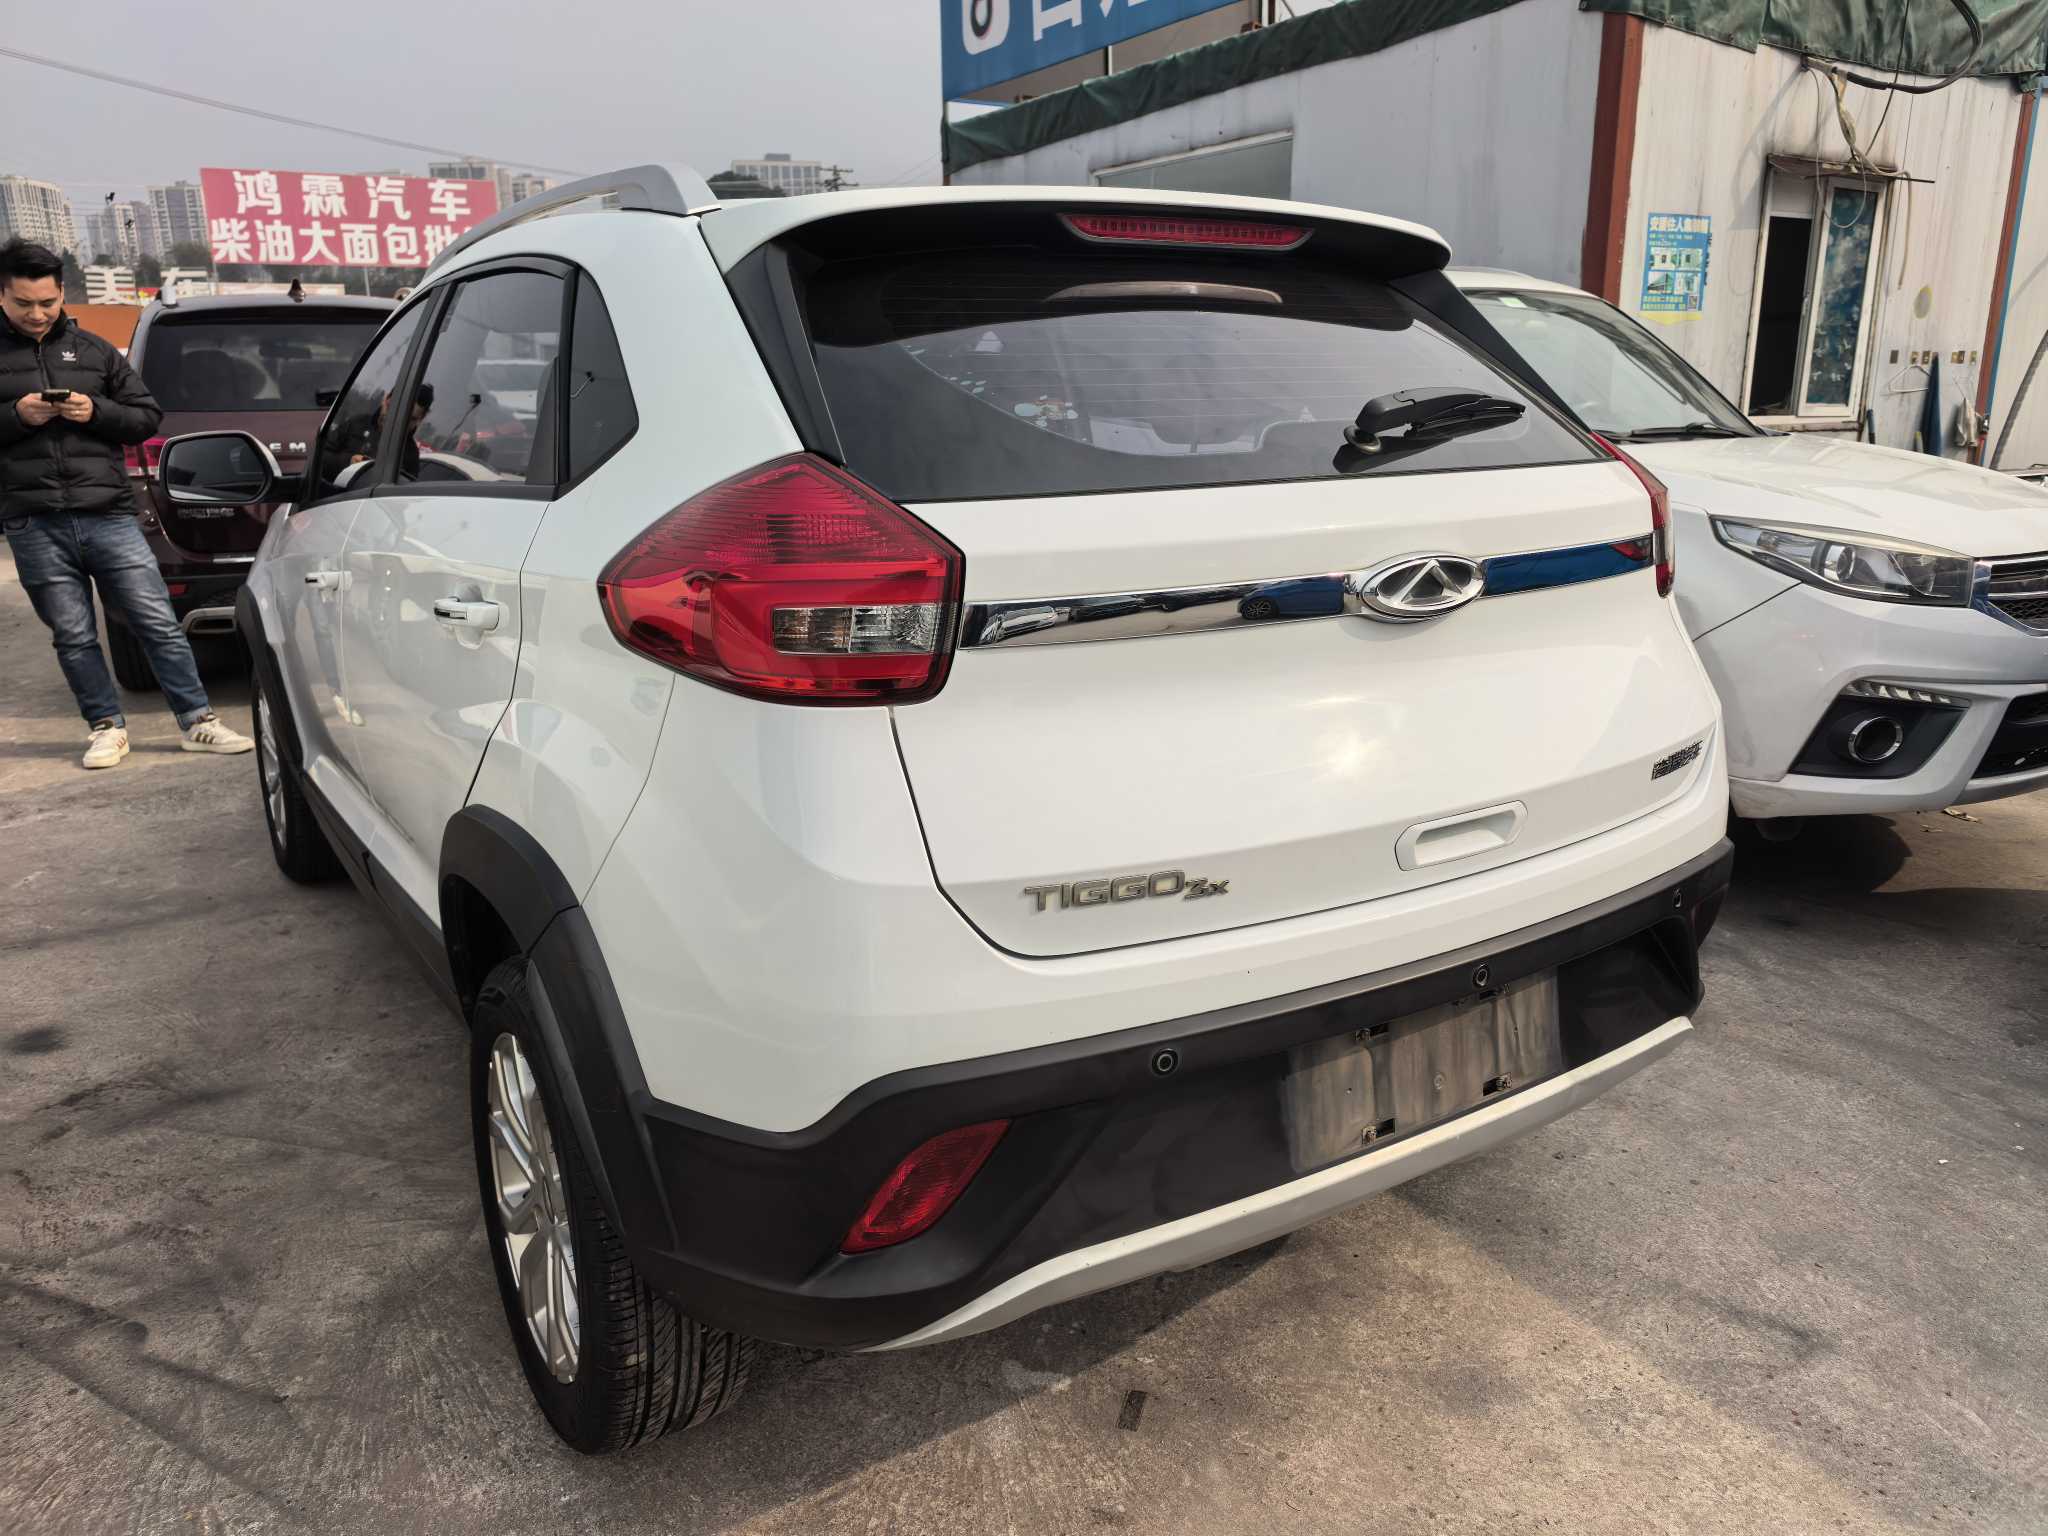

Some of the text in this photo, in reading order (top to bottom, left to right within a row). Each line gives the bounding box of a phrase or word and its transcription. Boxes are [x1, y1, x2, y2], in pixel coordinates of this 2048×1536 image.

[232, 170, 471, 221] 鸿霖汽车
[210, 217, 473, 266] 柴油大面包批
